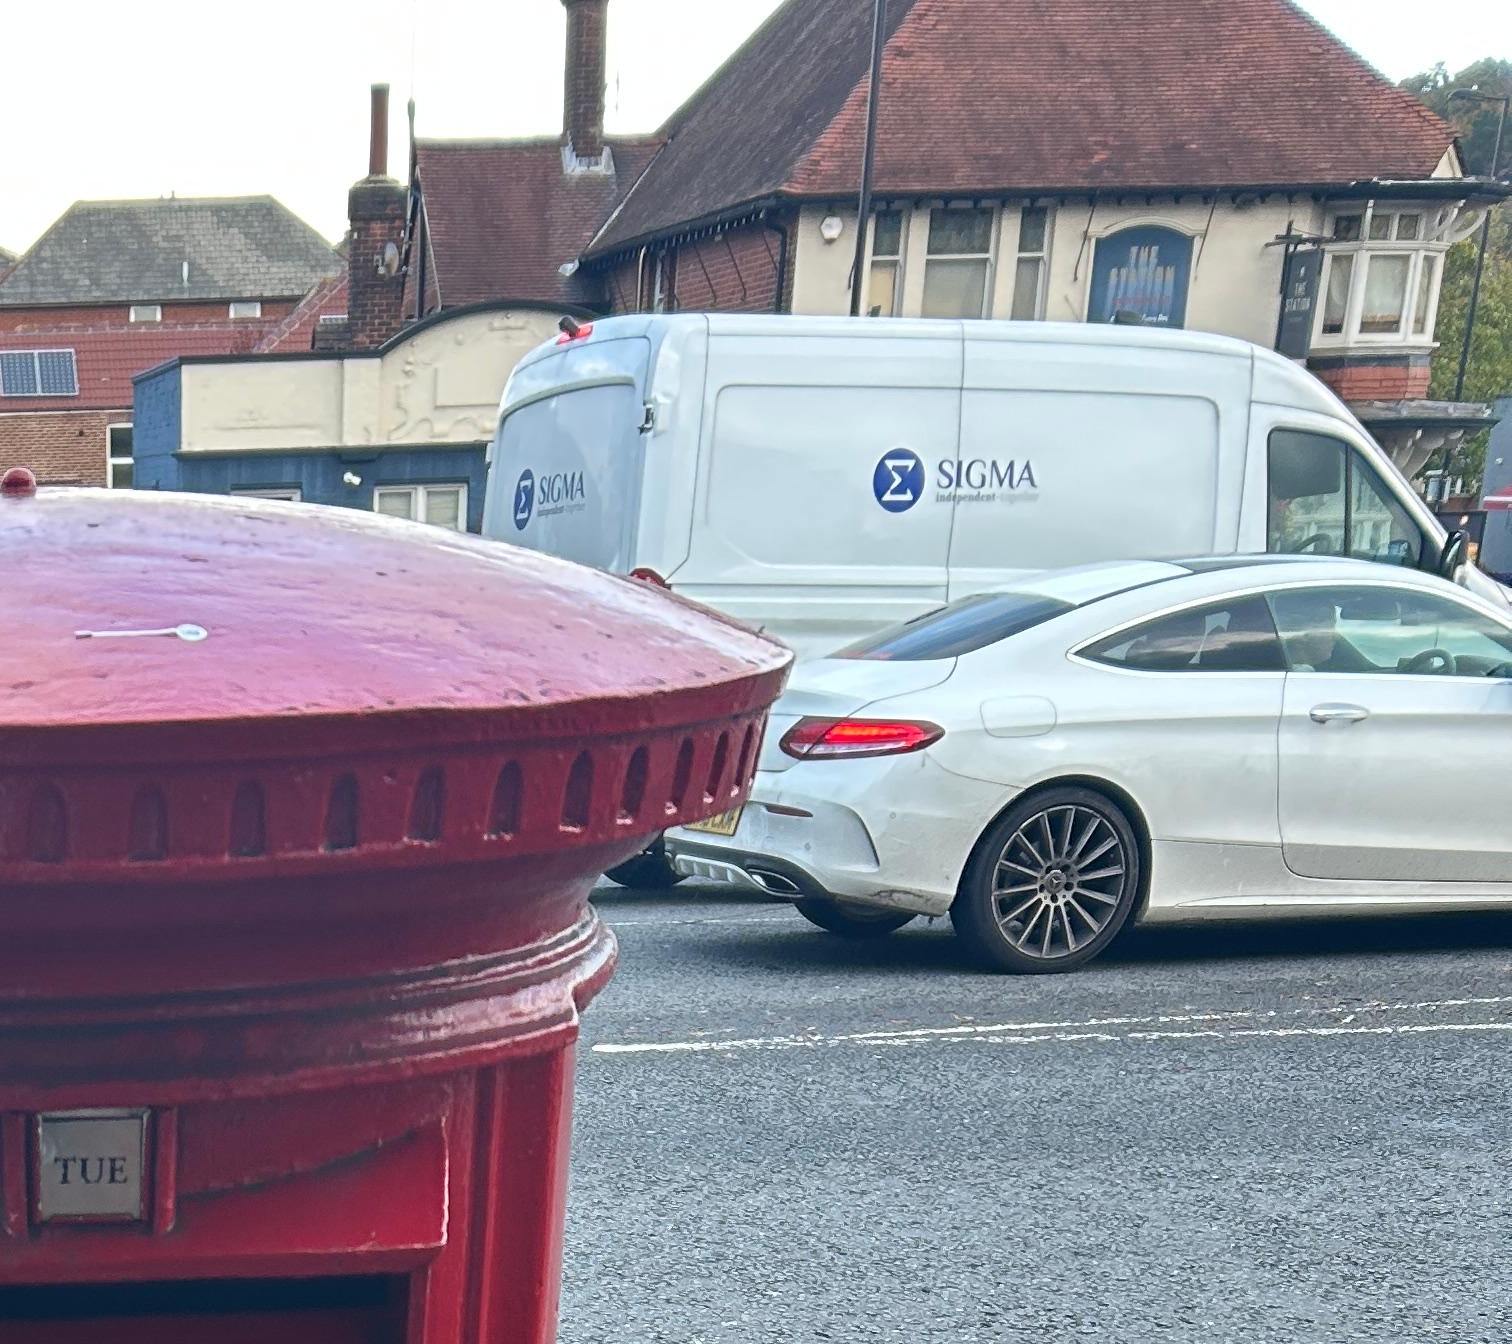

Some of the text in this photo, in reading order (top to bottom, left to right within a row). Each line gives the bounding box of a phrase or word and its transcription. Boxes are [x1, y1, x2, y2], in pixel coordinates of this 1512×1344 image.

[538, 470, 585, 505] SIGMA
[937, 459, 1038, 489] SIGMA
[54, 1156, 128, 1185] TUE
